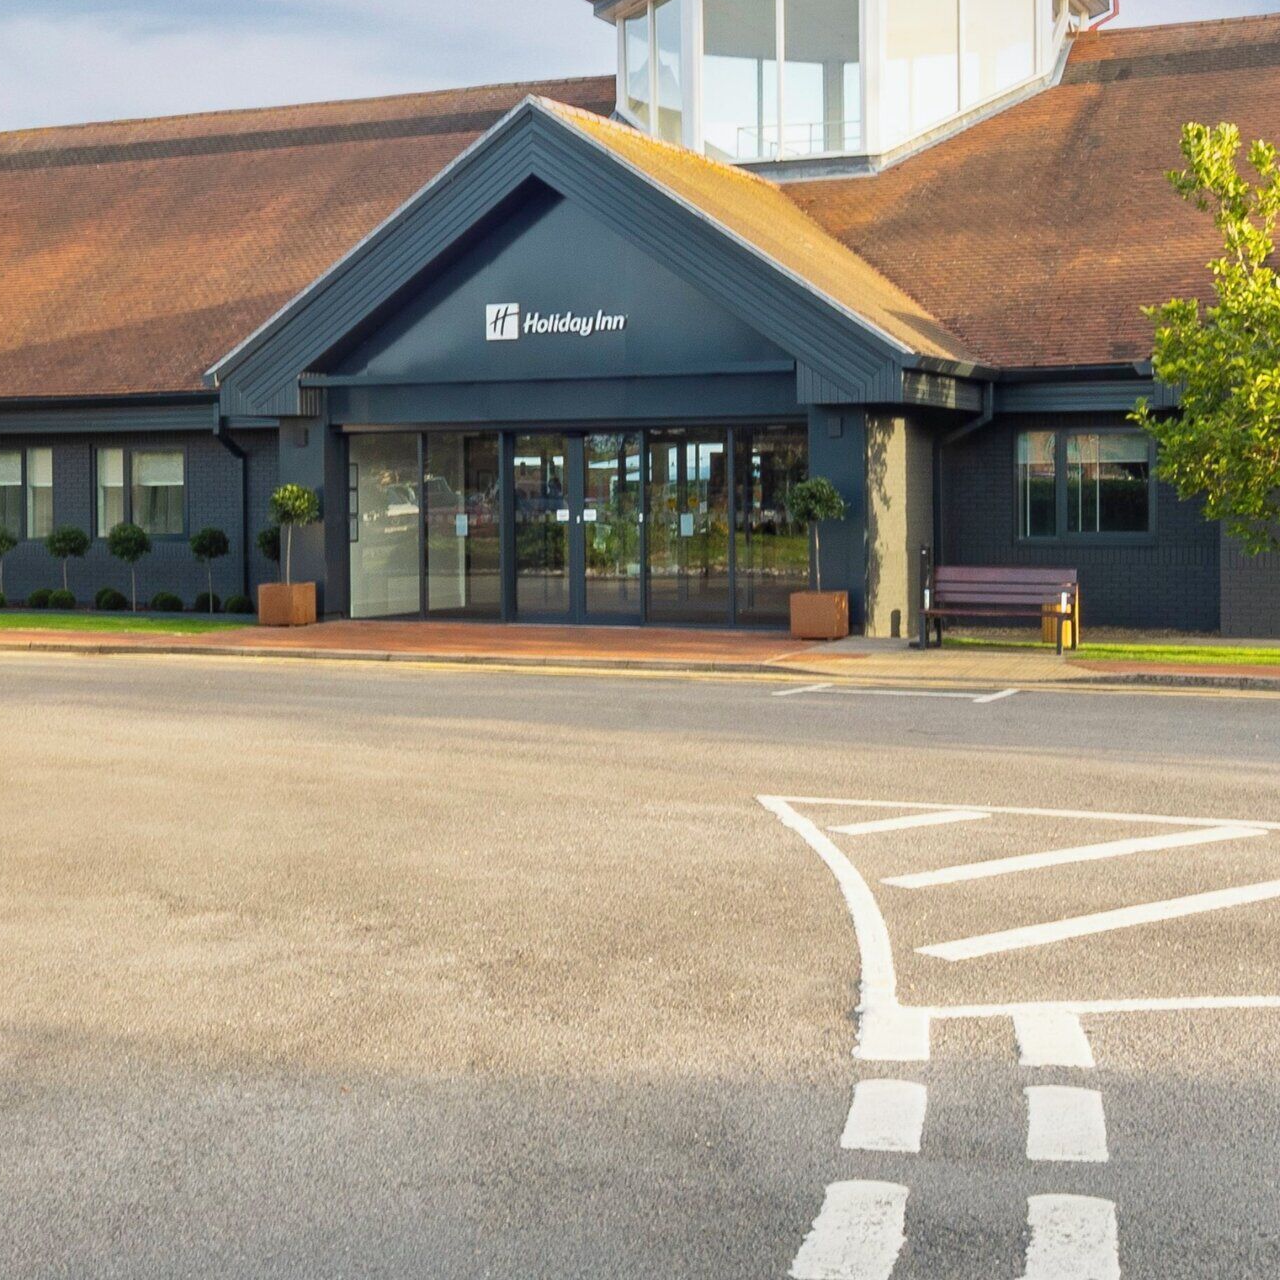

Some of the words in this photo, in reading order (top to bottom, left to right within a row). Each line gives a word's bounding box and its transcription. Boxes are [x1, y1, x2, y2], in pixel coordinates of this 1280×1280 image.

[489, 305, 518, 336] H
[523, 311, 593, 336] Holiday
[595, 309, 625, 331] Inn
